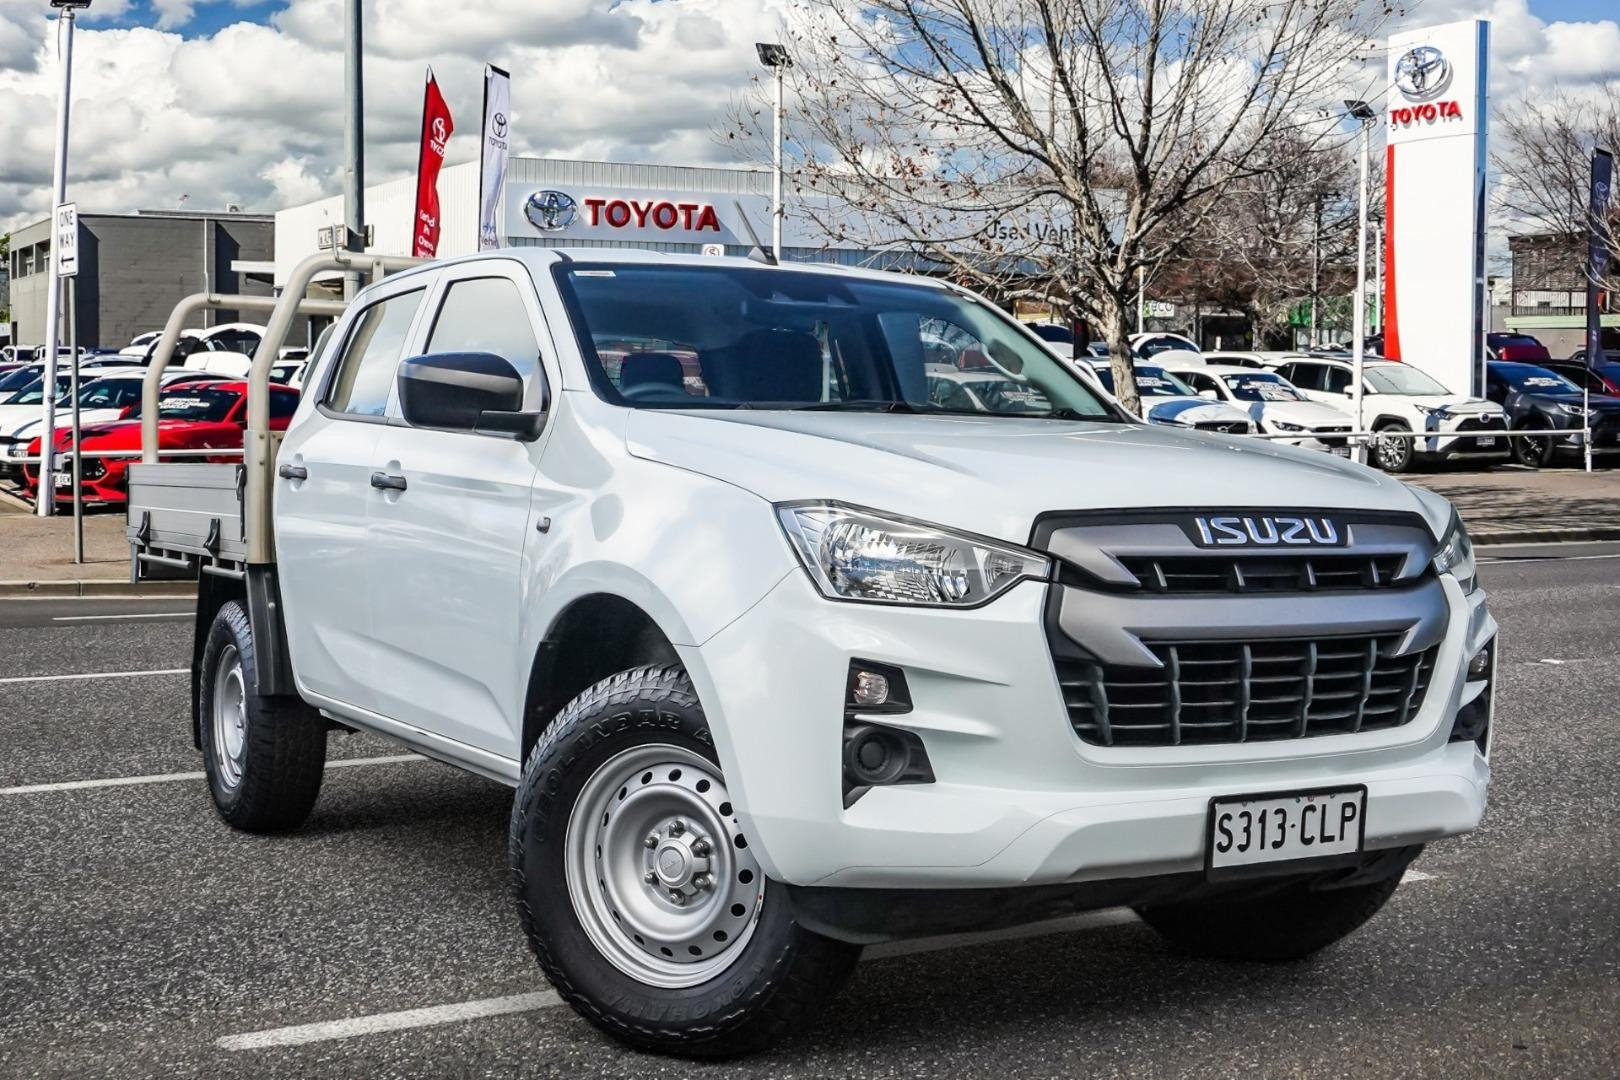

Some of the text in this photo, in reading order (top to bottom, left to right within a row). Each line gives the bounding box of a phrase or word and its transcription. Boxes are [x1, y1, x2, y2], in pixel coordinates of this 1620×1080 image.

[1390, 101, 1461, 124] TOYOTA
[60, 210, 73, 227] ONE
[585, 198, 720, 232] TOYOTA
[59, 232, 75, 248] WAY
[987, 221, 1030, 241] Used
[1195, 517, 1338, 545] ISUZU
